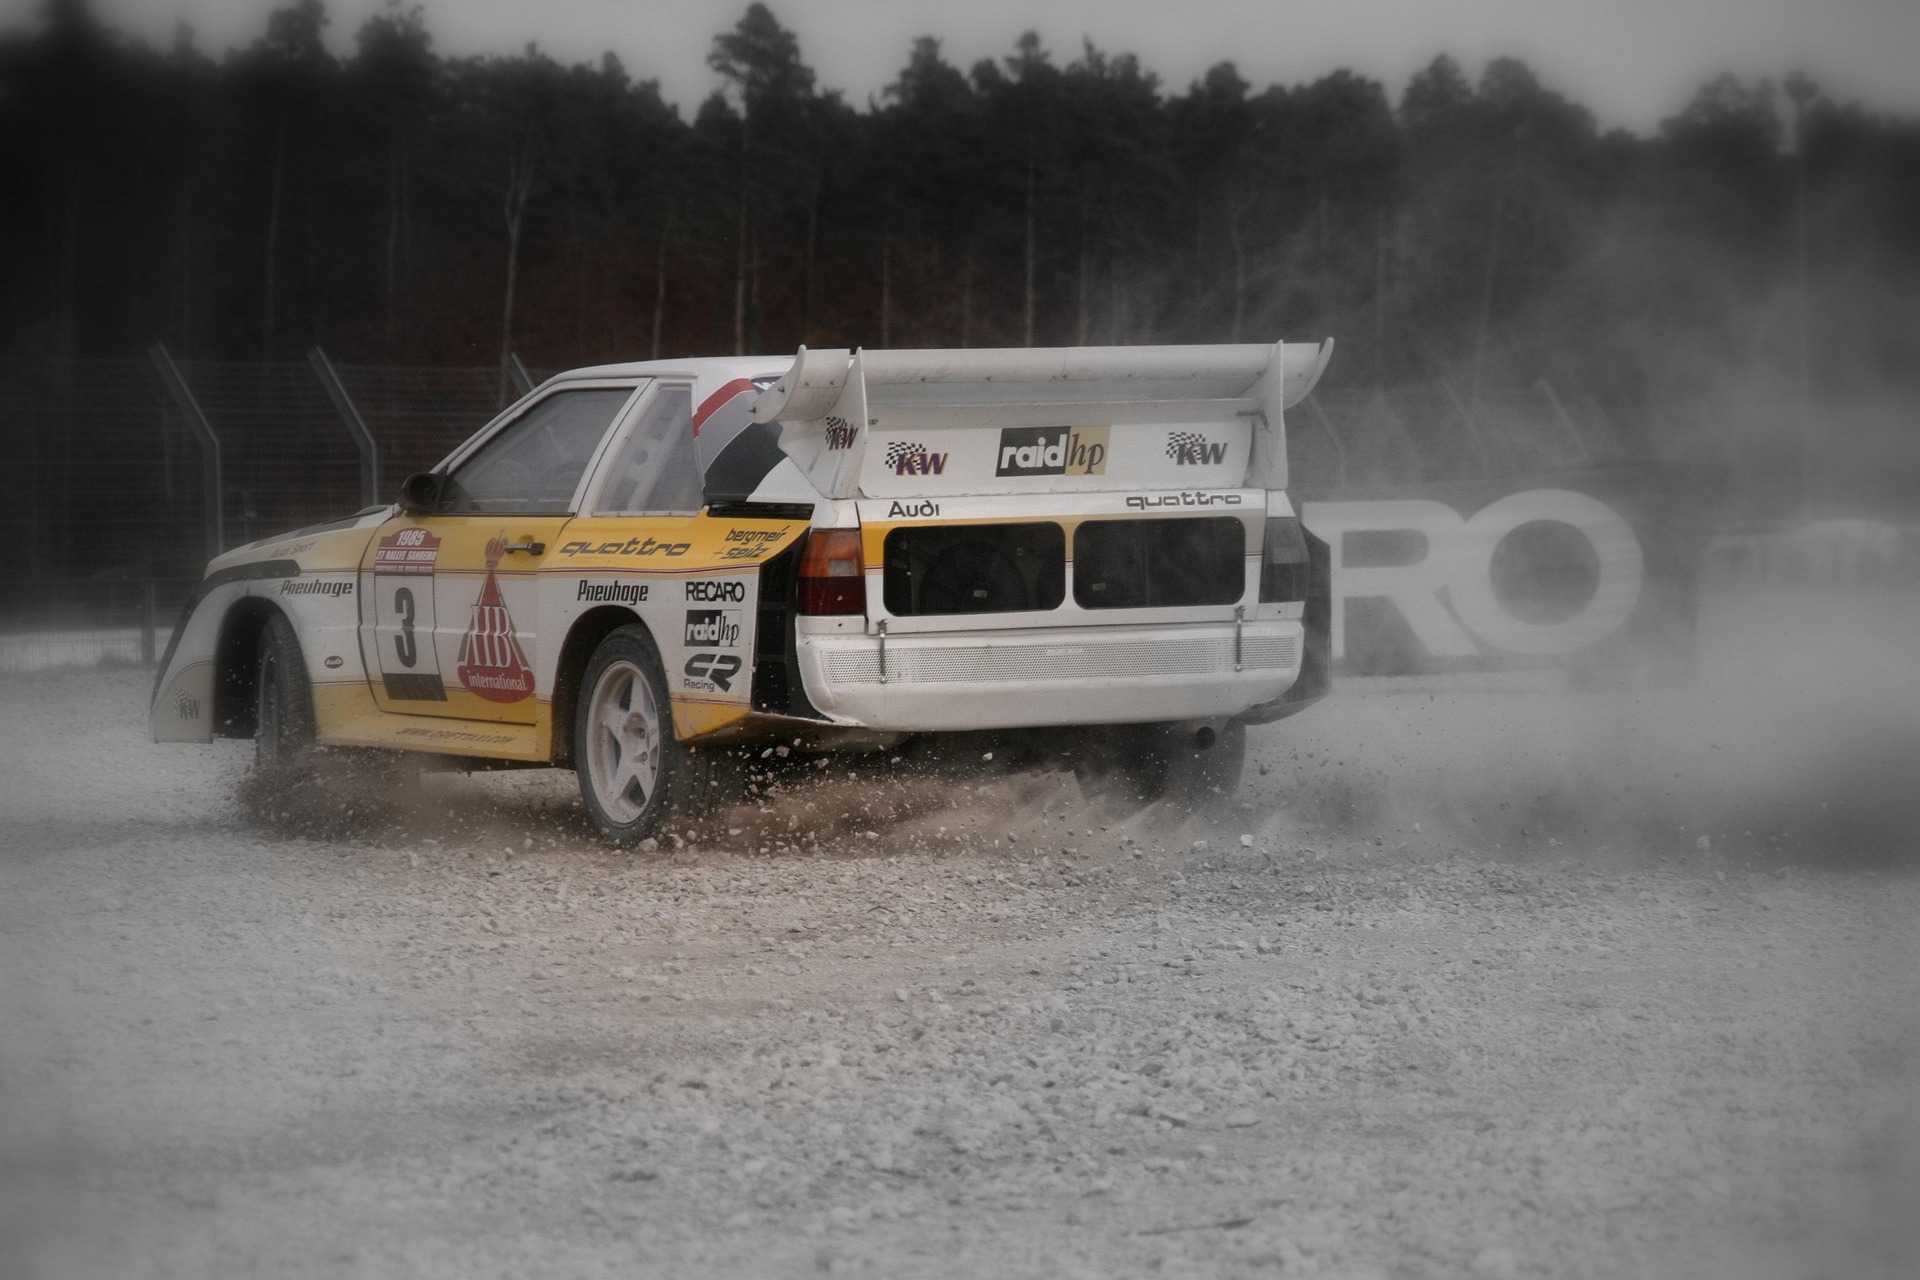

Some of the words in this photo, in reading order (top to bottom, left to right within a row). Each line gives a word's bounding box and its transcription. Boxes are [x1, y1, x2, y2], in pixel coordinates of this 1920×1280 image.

[829, 425, 858, 450] KW
[895, 452, 949, 476] KW
[1000, 434, 1068, 469] raid
[1069, 433, 1105, 474] hp
[1176, 442, 1228, 466] KW
[888, 500, 940, 518] Audi
[1126, 491, 1242, 510] quattro
[396, 530, 426, 546] 1985
[725, 524, 792, 546] bergmeir
[406, 551, 437, 561] SANREMO
[559, 537, 691, 558] quattro
[280, 579, 354, 598] Pneuhage
[577, 580, 649, 605] Pneuhage
[685, 581, 745, 603] RECARO
[394, 586, 416, 669] 3
[470, 606, 512, 668] HB
[686, 616, 721, 642] raid
[721, 615, 740, 647] hp
[467, 670, 526, 691] international
[683, 678, 715, 693] Racing
[179, 698, 201, 719] KW
